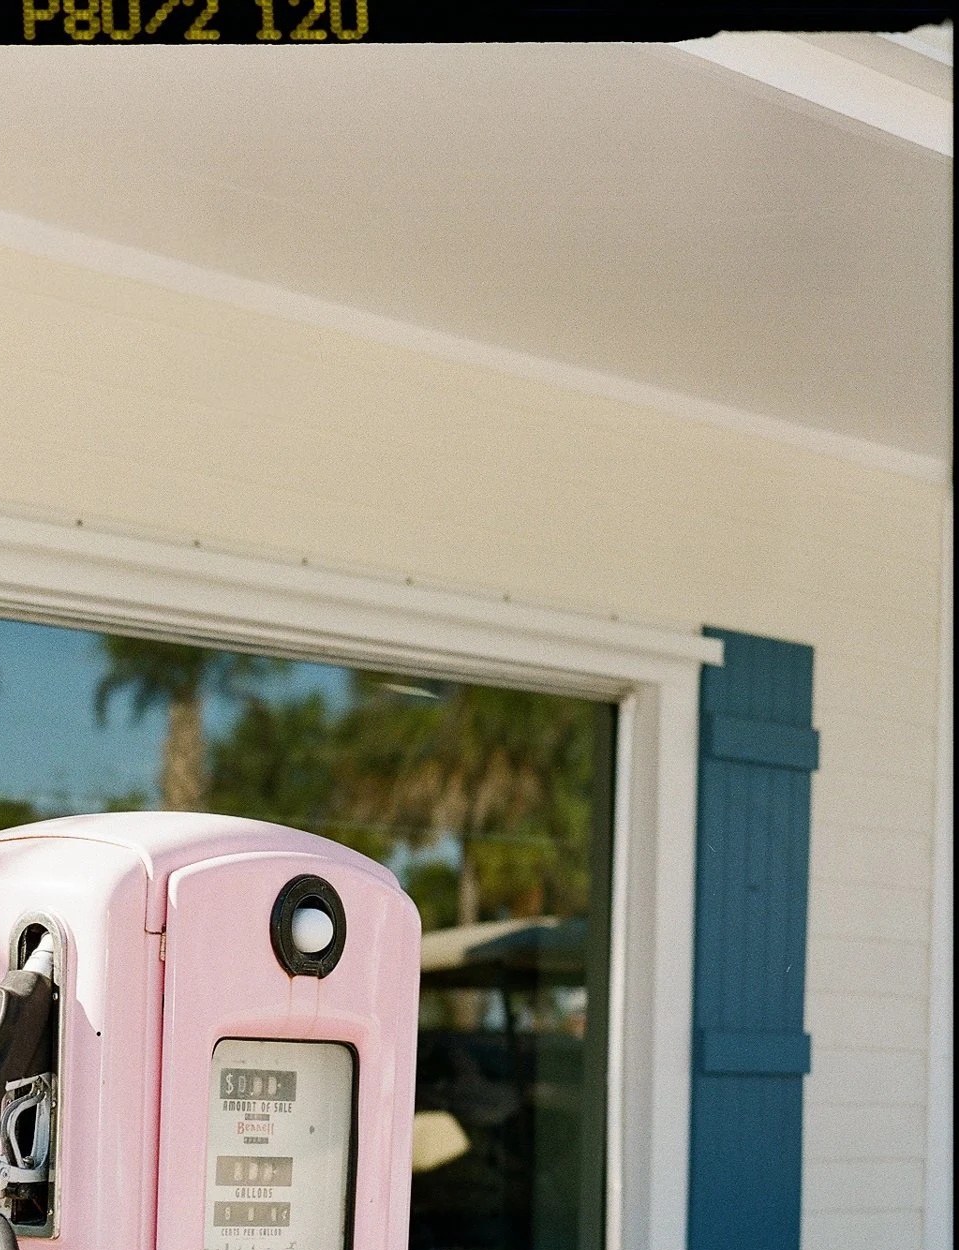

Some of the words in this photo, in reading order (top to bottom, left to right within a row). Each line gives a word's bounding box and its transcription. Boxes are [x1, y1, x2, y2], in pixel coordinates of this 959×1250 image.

[223, 1100, 256, 1112] AMOUNT
[261, 1101, 271, 1113] OF
[274, 1102, 292, 1113] SALE
[235, 1187, 273, 1198] GALLONS
[221, 1228, 240, 1236] CENTS
[243, 1228, 255, 1236] PER
[259, 1228, 282, 1236] GALLON
